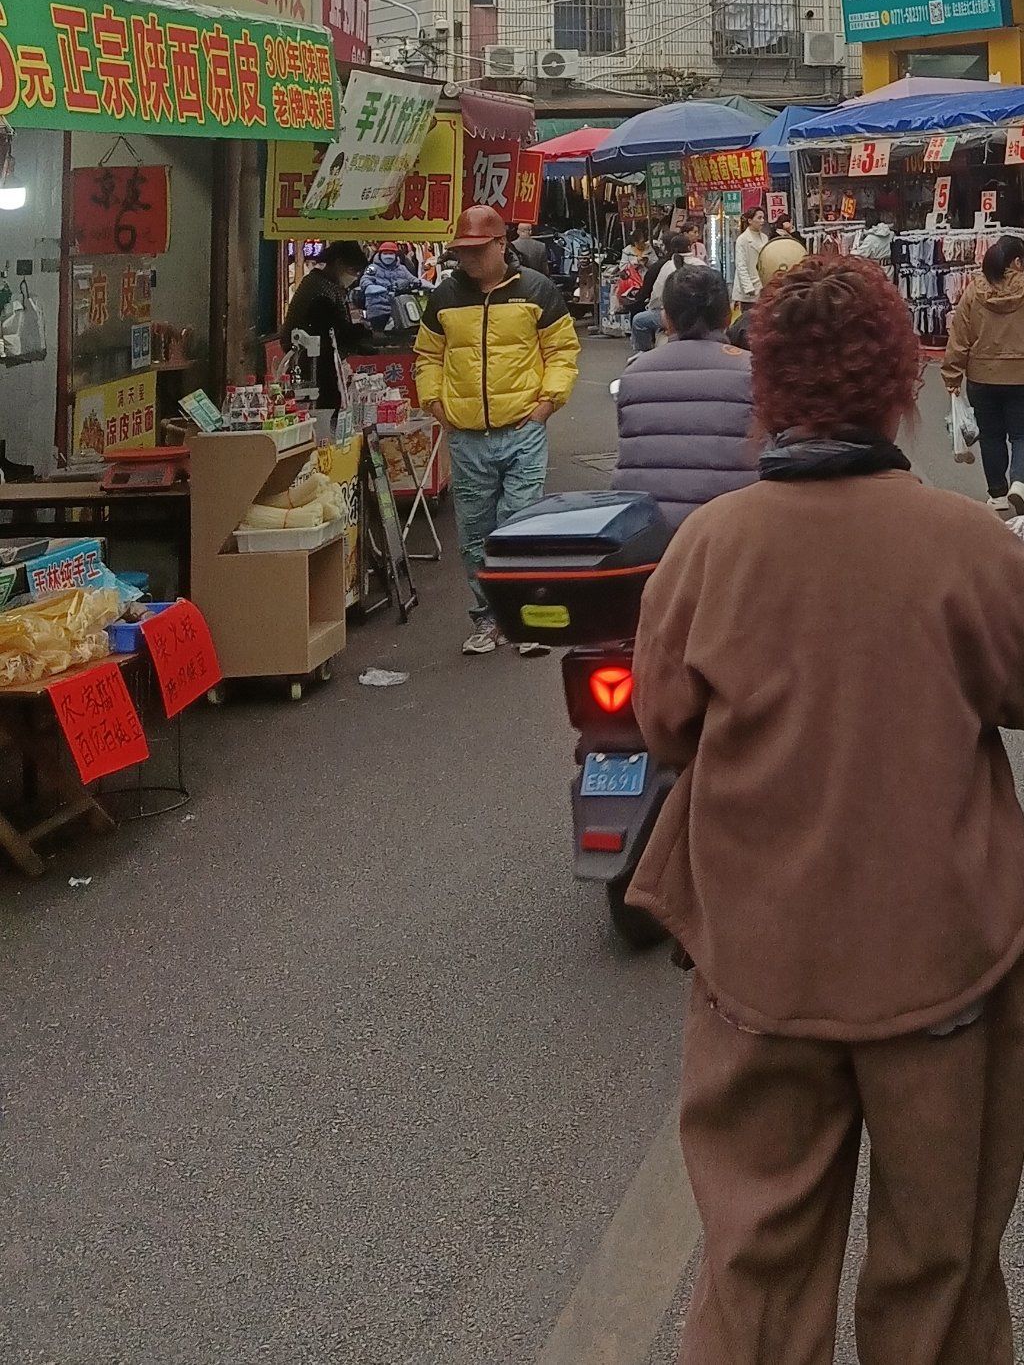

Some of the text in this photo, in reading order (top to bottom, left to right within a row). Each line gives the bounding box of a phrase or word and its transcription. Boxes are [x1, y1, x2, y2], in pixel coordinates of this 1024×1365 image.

[51, 3, 266, 127] 正宗陕西凉皮
[264, 35, 333, 85] 30年陕西
[274, 82, 335, 130] 老牌味道
